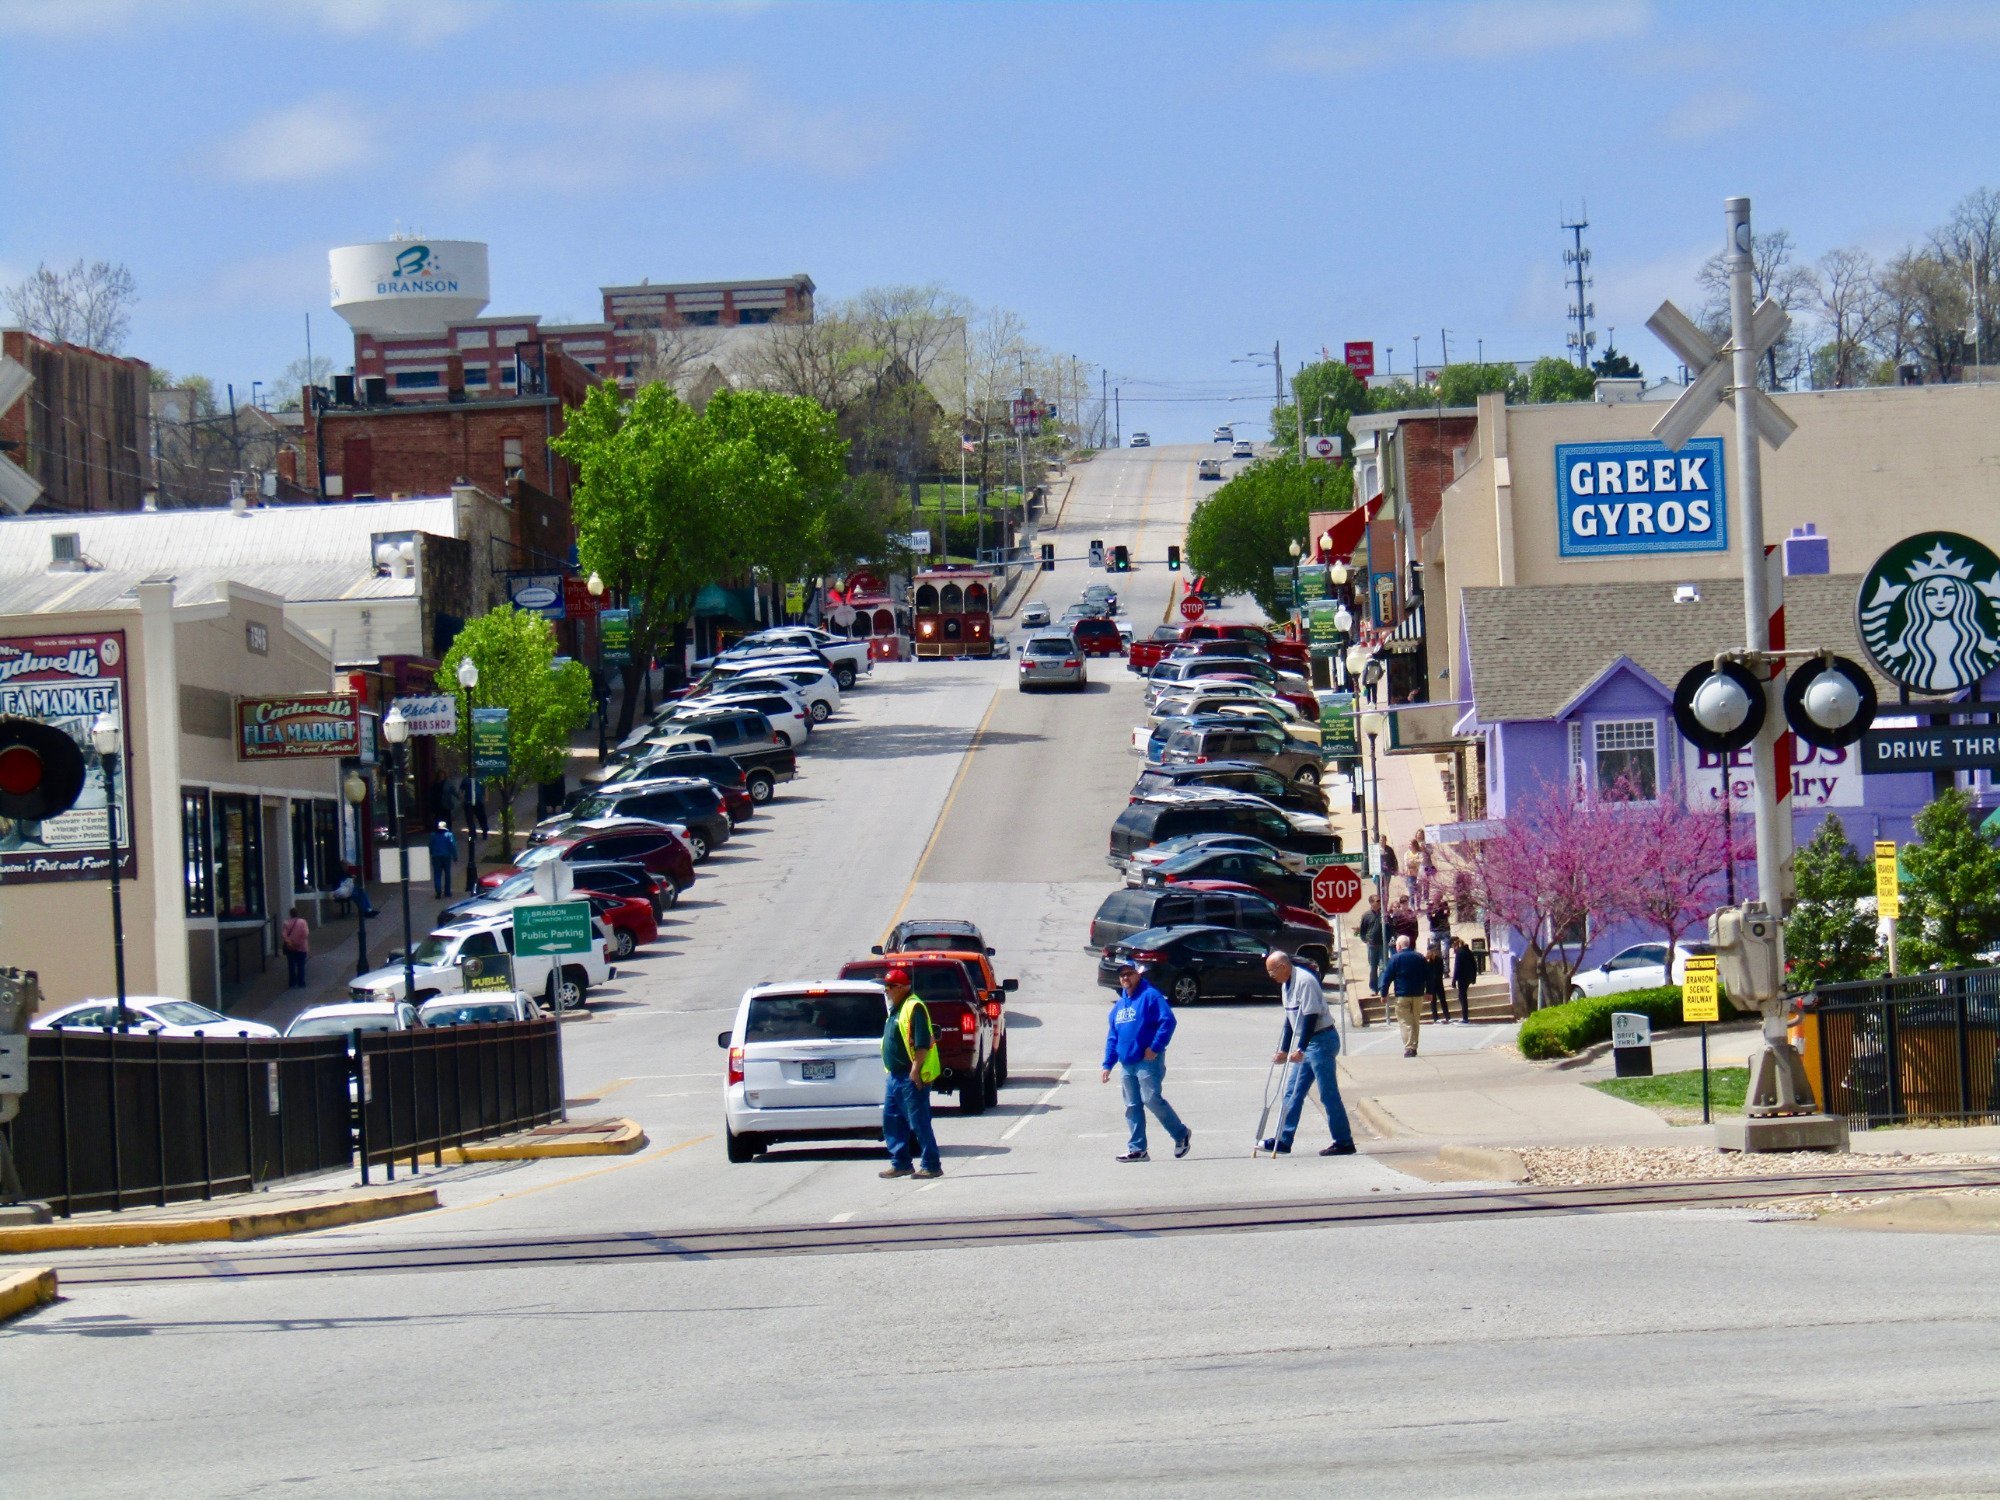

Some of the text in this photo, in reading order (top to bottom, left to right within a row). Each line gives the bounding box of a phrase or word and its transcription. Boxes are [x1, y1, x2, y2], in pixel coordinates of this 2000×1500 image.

[377, 280, 459, 294] BRANSON
[1570, 457, 1709, 496] GREEK
[1571, 500, 1711, 537] GYROS
[1182, 603, 1203, 614] STOP
[0, 648, 98, 680] adwell's
[0, 687, 113, 717] EA MARKET
[401, 700, 449, 718] Chick's
[256, 700, 352, 724] Cadwell's
[408, 719, 450, 730] RBER SHOP
[243, 724, 285, 745] FLEA
[286, 721, 356, 742] MARKET
[1698, 733, 1848, 769] BEDS
[1878, 737, 2000, 759] DRIVE THR
[1711, 771, 1840, 804] Jelry
[0, 860, 31, 873] anson's
[60, 861, 80, 870] and
[1308, 856, 1350, 865] Sycamore
[1316, 880, 1359, 899] STOP
[531, 909, 567, 917] BRANSON
[521, 929, 585, 940] Public Parking
[472, 975, 506, 988] PUBLIC
[1686, 975, 1714, 984] BRANSON
[1689, 985, 1711, 994] SCENIC
[1687, 995, 1713, 1004] RAILWAY
[1616, 1032, 1635, 1040] DRIVE
